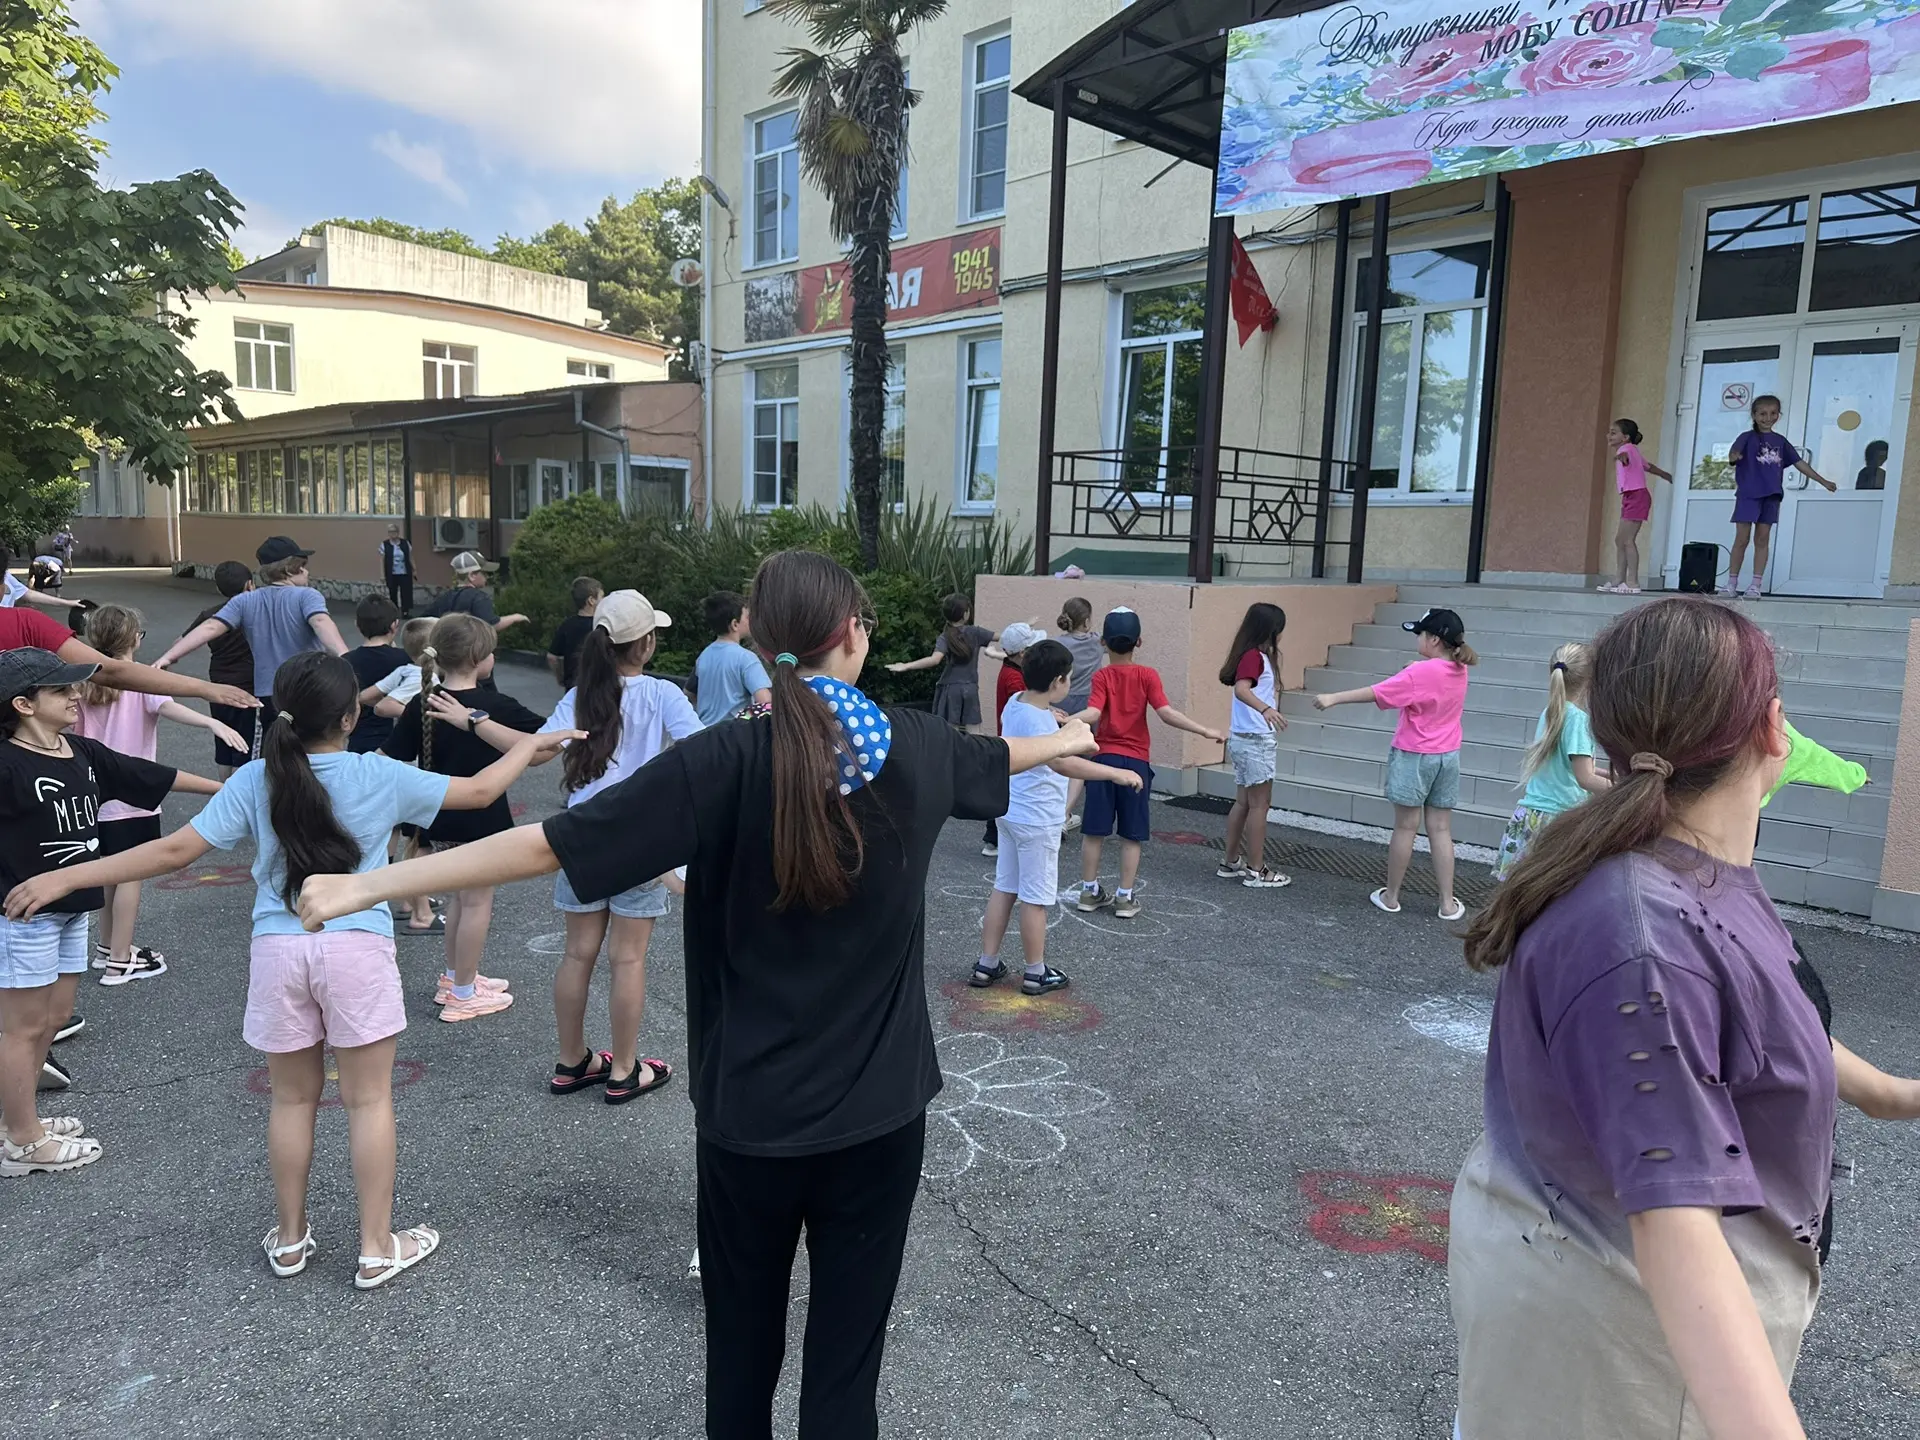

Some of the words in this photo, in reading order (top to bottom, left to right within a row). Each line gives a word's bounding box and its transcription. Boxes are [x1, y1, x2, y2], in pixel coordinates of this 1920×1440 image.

[1319, 1, 1521, 67] Выпускники
[1478, 18, 1561, 63] МОБУ
[1573, 0, 1651, 36] СОШ
[1414, 110, 1479, 151] Куда
[1473, 113, 1569, 140] уходит
[953, 246, 990, 274] 1941
[885, 266, 924, 310] АЯ
[954, 267, 994, 295] 1945
[53, 794, 98, 833] MEO
